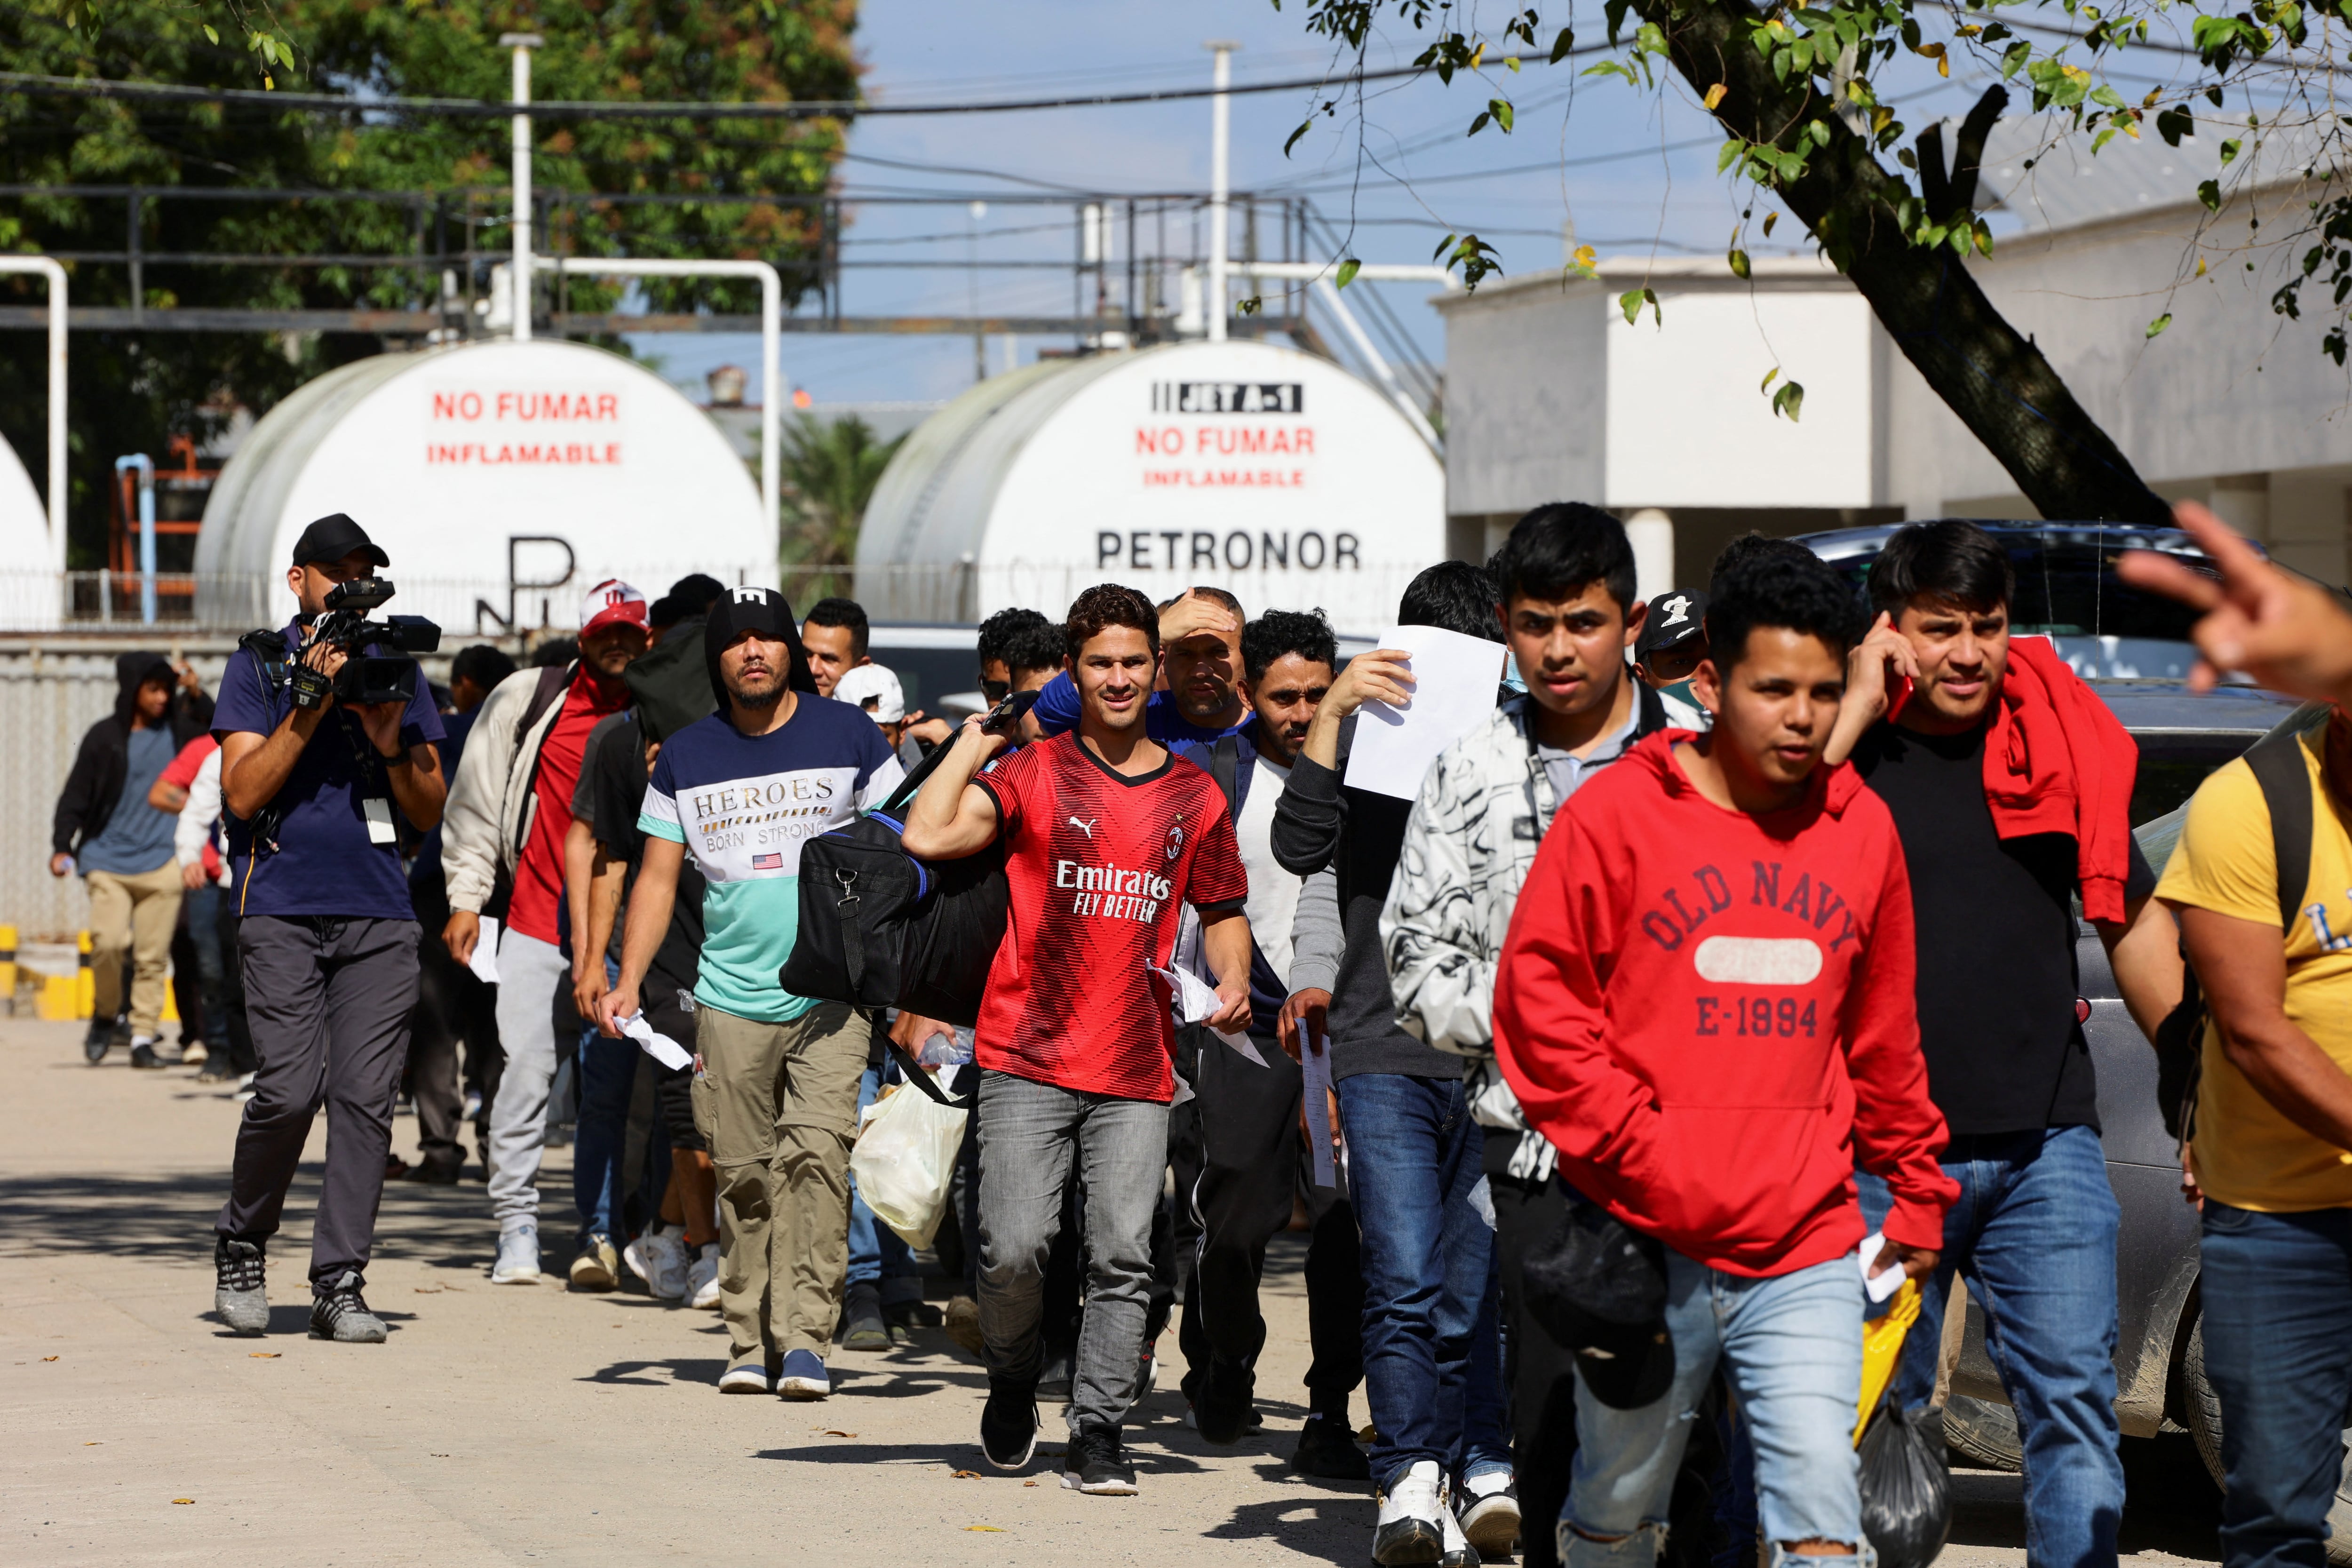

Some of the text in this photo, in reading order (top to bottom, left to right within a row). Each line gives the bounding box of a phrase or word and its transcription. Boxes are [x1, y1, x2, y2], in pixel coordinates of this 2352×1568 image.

[433, 391, 619, 422] NO FUMAR
[1181, 383, 1294, 412] JET A-1
[427, 443, 620, 465] INFLAMABLE
[1136, 427, 1315, 456] NO FUMAR
[1144, 470, 1305, 487] INFLAMABLE
[1097, 531, 1359, 570] PETRONOR
[693, 777, 834, 819] HEROES
[707, 821, 825, 852] BORN STRONG
[1056, 860, 1171, 900] Emirates
[1073, 892, 1158, 923] FLY BETTER
[1641, 860, 1858, 953] OLD NAVY
[1695, 997, 1818, 1038] E-1994
